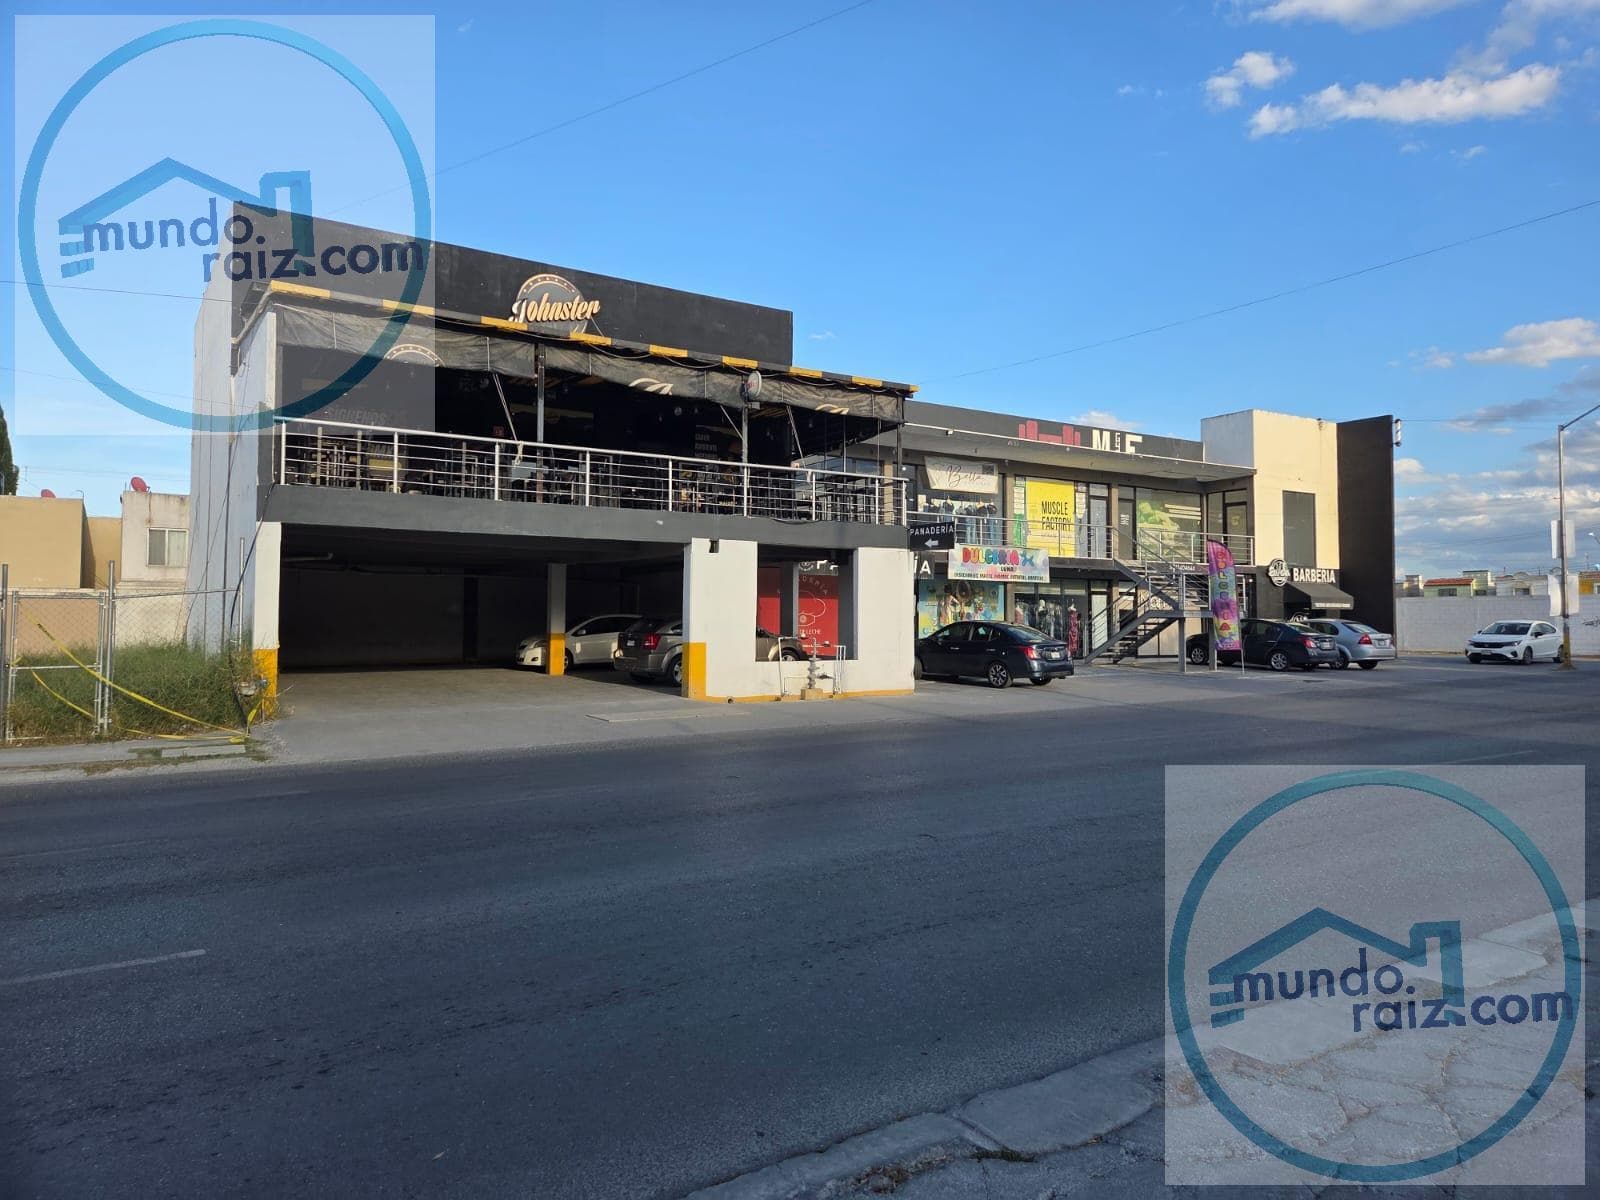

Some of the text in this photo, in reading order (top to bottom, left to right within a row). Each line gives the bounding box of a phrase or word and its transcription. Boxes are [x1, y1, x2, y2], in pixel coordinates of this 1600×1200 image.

[508, 292, 600, 323] Johnster
[1041, 501, 1068, 516] MUSCLE
[909, 524, 955, 537] PANADERÍA
[1041, 516, 1072, 532] FACTORY
[1292, 567, 1336, 584] BARBERIA
